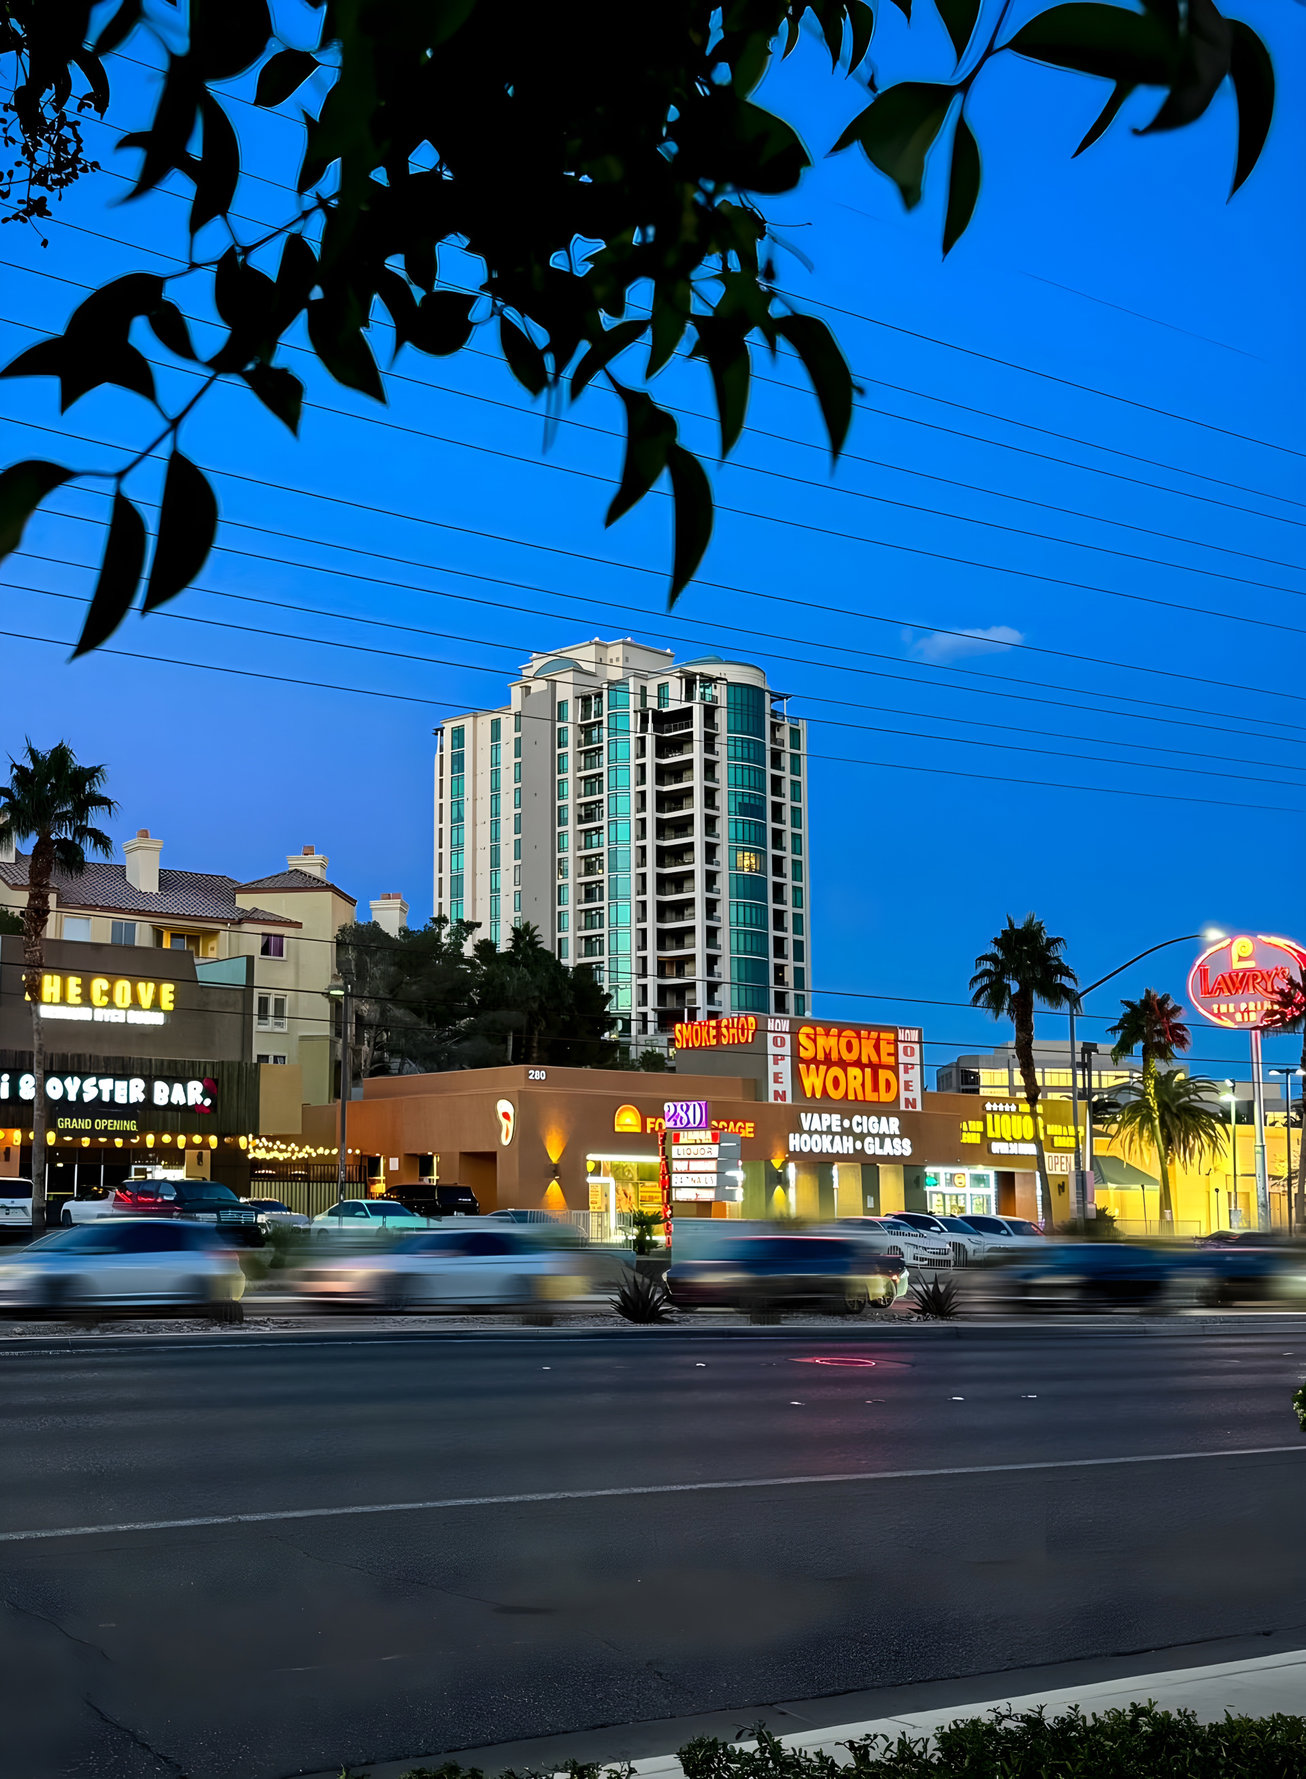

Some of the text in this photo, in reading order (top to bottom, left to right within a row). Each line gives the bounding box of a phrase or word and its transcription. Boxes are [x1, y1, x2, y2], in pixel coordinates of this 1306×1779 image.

[22, 974, 175, 1011] HE COVE
[1199, 965, 1289, 1001] LAWRY'S
[674, 1015, 757, 1049] SMOKE SHOP
[767, 1018, 790, 1032] NOW
[898, 1029, 919, 1042] NOW
[797, 1025, 896, 1066] SMOKE
[528, 1069, 546, 1080] 280
[772, 1035, 787, 1102] OPEN
[902, 1045, 917, 1110] OPEN
[46, 1076, 146, 1103] OYSTER
[798, 1063, 898, 1102] WORLD
[57, 1118, 138, 1132] GRAND OPENING
[664, 1102, 706, 1128] 280
[800, 1113, 901, 1135] VAPE CIGAR
[788, 1133, 912, 1157] HOOKAH GLASS
[1047, 1155, 1073, 1172] OPEN
